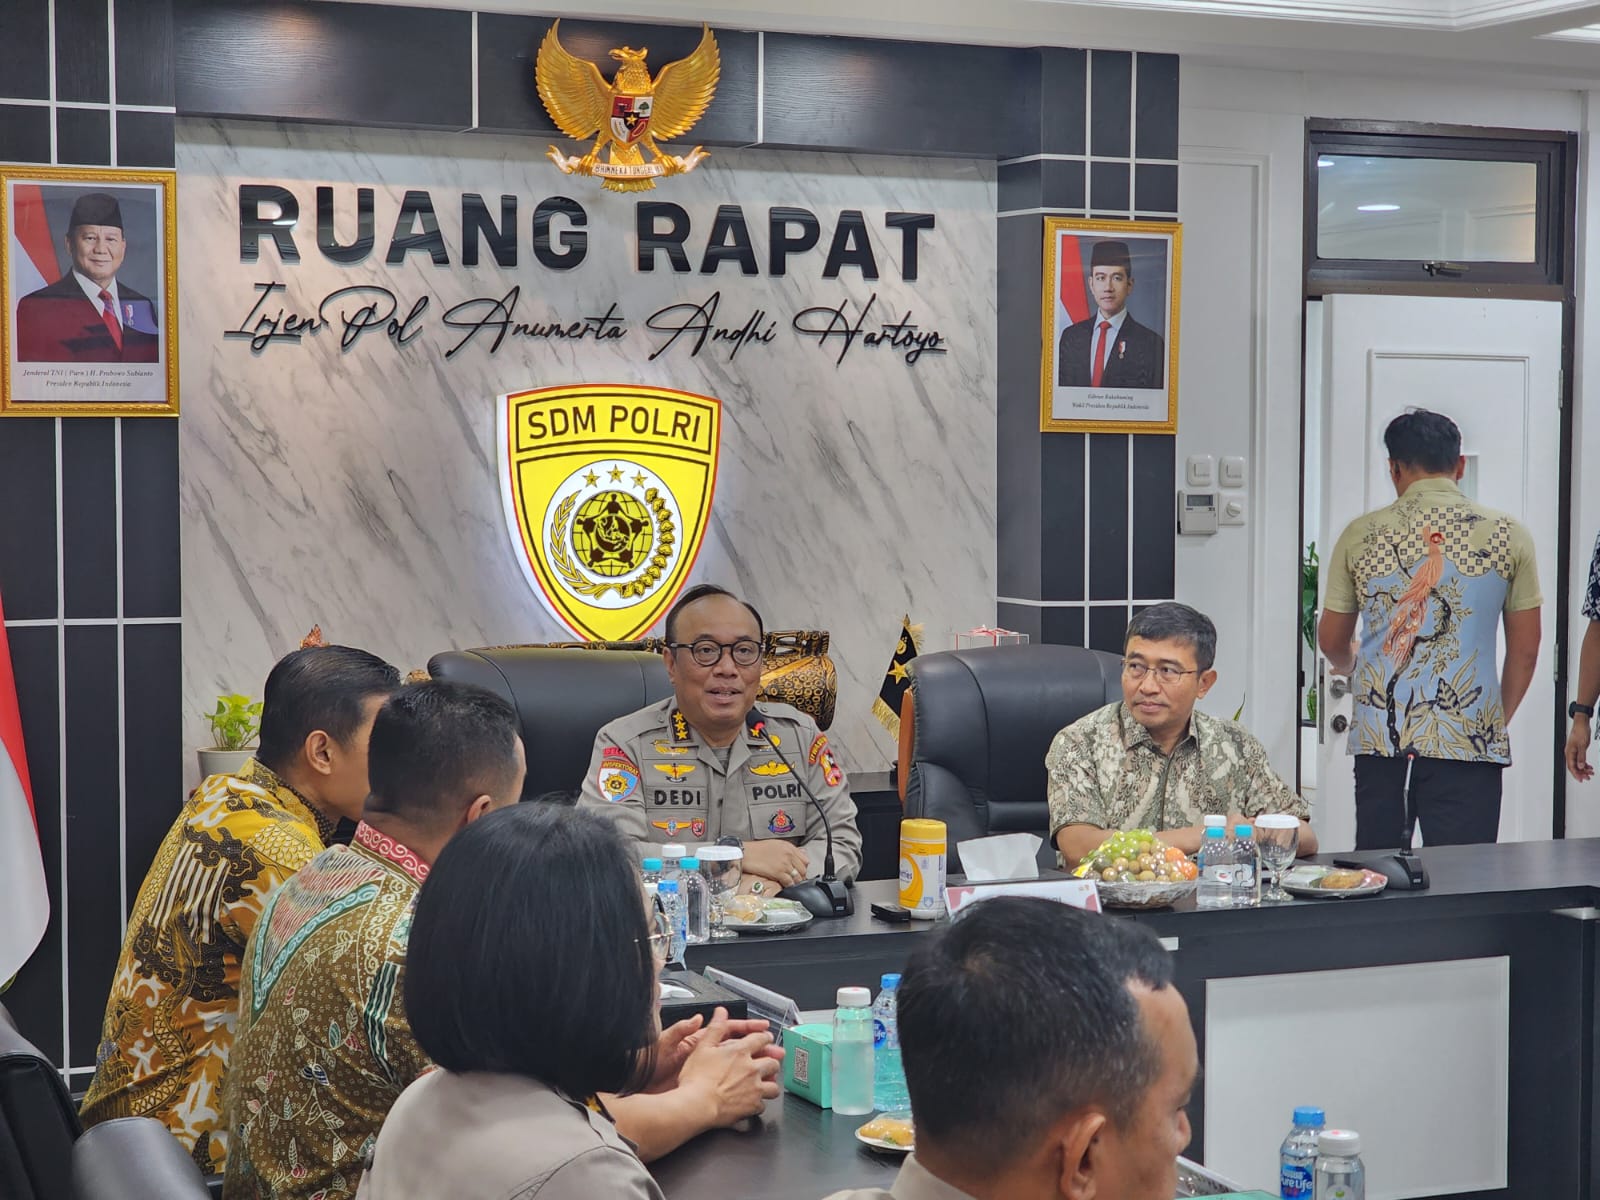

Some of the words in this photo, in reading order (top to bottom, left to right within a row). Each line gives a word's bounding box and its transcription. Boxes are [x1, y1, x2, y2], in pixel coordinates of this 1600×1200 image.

[239, 184, 588, 269] RUANG
[637, 201, 935, 281] RAPAT
[224, 281, 321, 351] Irjen
[319, 285, 429, 348] Pol
[442, 285, 628, 358] Anumerta
[646, 291, 777, 361] Andhi
[793, 293, 947, 364] Hartoyo
[528, 405, 596, 440] SDM
[609, 405, 701, 442] POLRI
[654, 790, 700, 806] DEDI
[752, 783, 801, 801] POLRI
